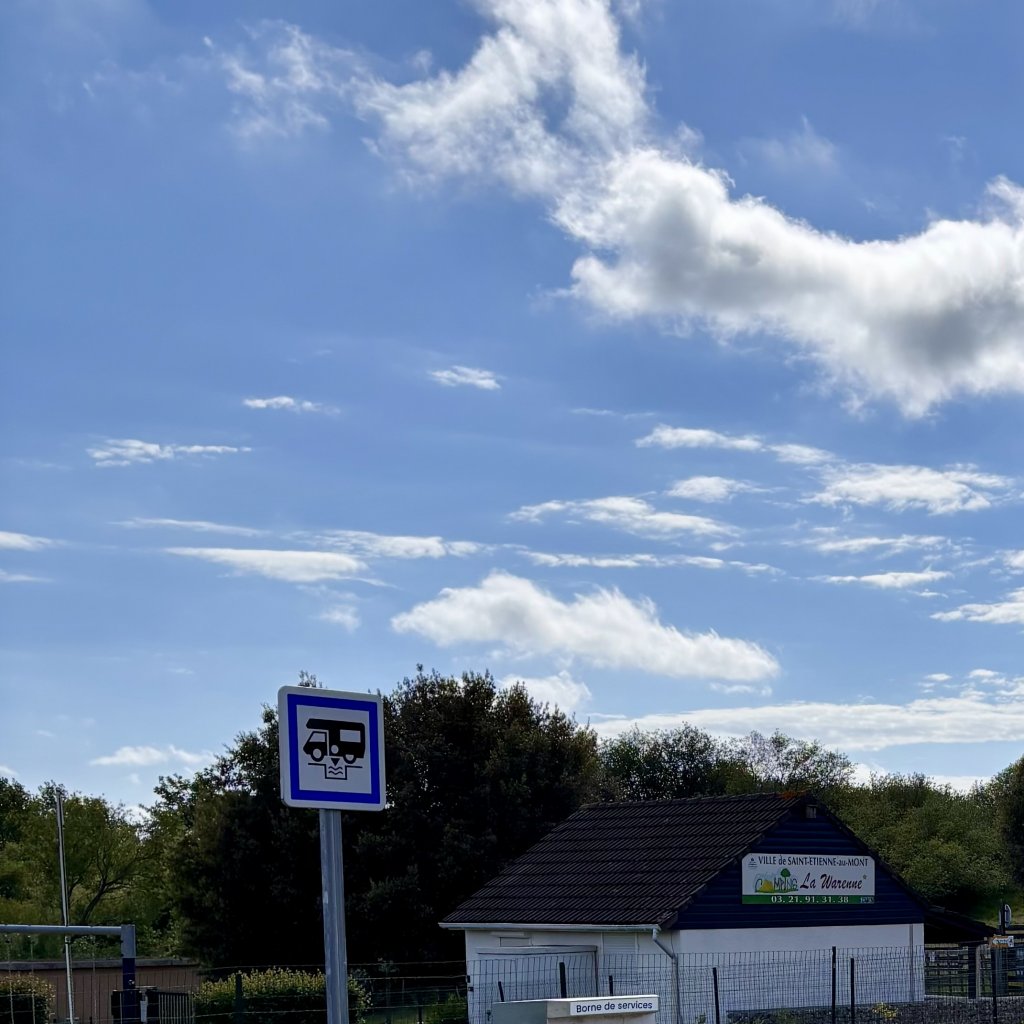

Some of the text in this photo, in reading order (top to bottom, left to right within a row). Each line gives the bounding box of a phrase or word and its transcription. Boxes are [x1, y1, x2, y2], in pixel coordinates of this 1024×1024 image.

[758, 856, 777, 865] VILLE
[779, 856, 787, 865] de
[800, 872, 816, 889] La
[820, 873, 863, 890] Warenne
[576, 1001, 653, 1013] Borne de services
